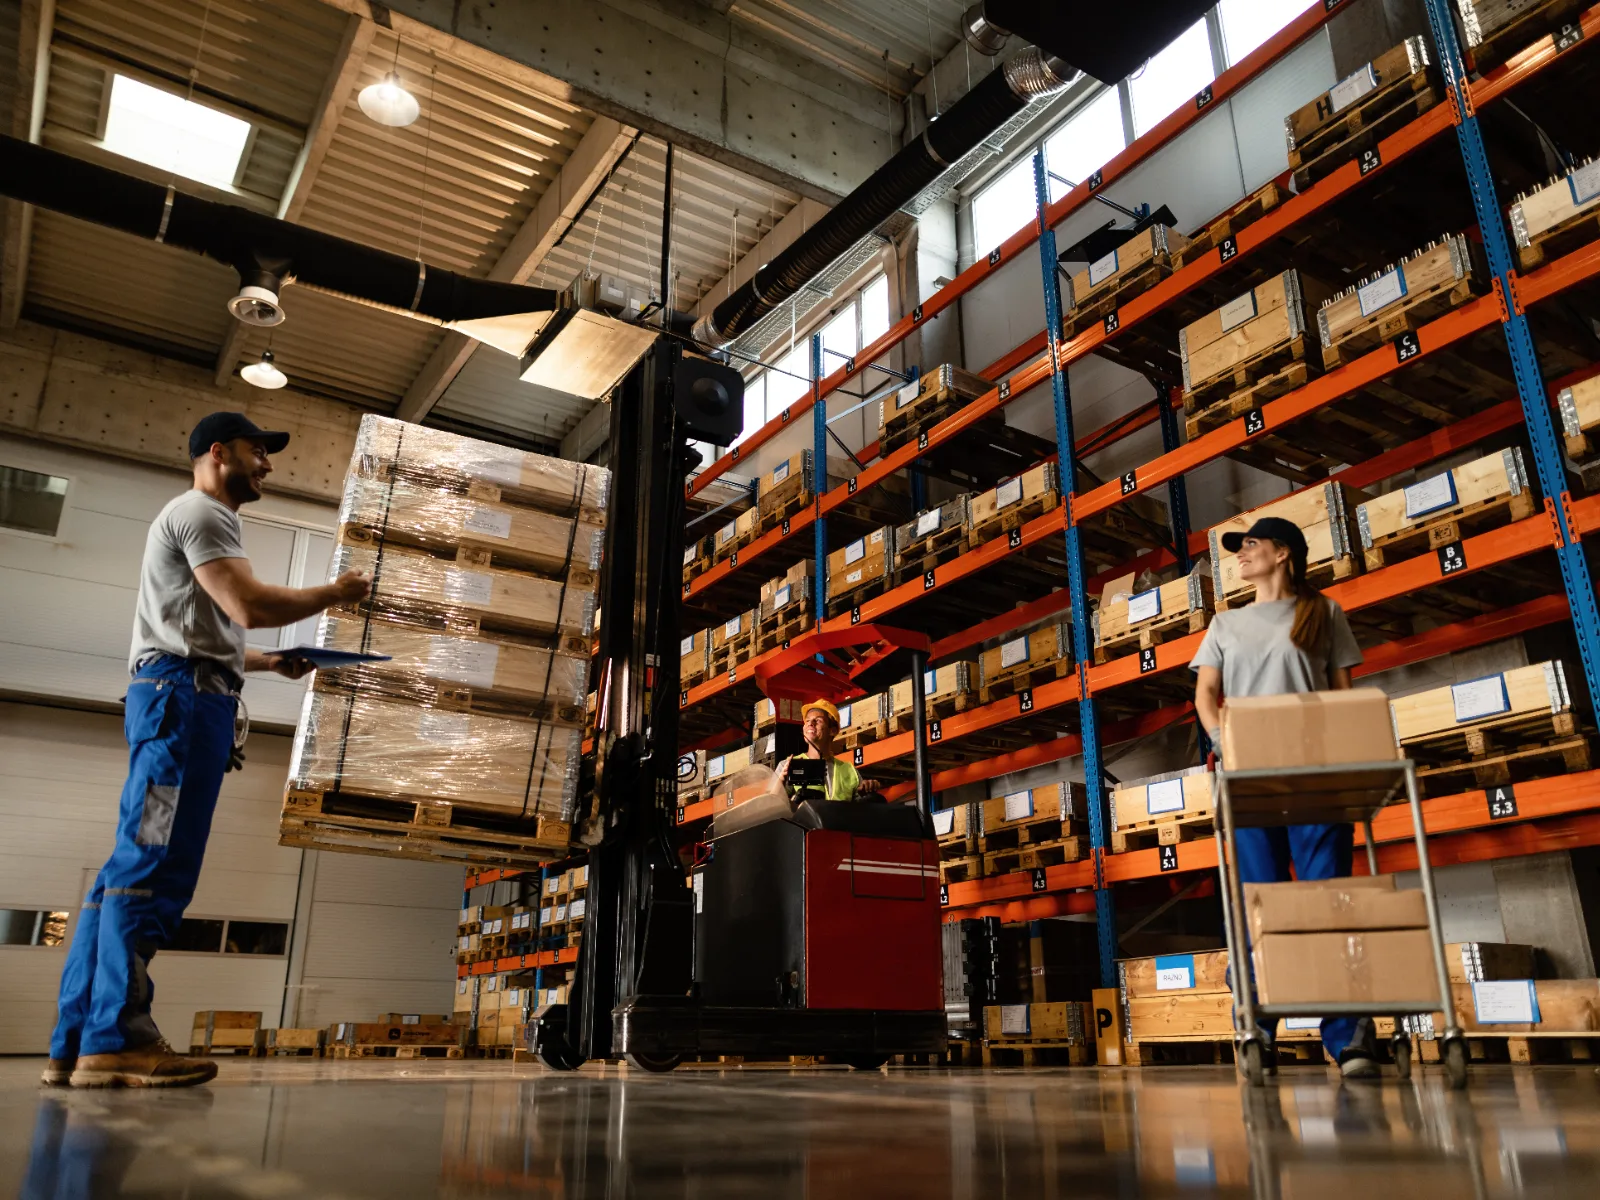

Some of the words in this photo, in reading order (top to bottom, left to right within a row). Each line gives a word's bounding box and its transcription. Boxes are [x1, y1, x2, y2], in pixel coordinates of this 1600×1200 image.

[1562, 24, 1572, 35] D
[1560, 31, 1579, 48] 6.1
[1198, 95, 1211, 107] 5.2
[1364, 151, 1372, 161] D
[1362, 157, 1378, 172] 5.3
[1091, 177, 1102, 188] 5.1
[1224, 241, 1231, 249] D
[1223, 247, 1235, 260] 5.2
[1107, 321, 1117, 332] 5.1
[1402, 335, 1410, 346] C
[1400, 344, 1417, 359] 5.3
[1000, 389, 1010, 399] 4.3
[1250, 411, 1257, 420] C
[1248, 420, 1262, 433] 5.2
[1125, 473, 1131, 482] C
[1124, 481, 1135, 493] 5.1
[1010, 537, 1020, 547] 4.3
[1446, 547, 1455, 558] B
[1444, 557, 1463, 572] 5.3
[927, 571, 932, 579] C
[1144, 650, 1151, 659] B
[1142, 660, 1154, 671] 5.1
[1023, 692, 1029, 700] B
[1021, 700, 1031, 710] 4.3
[931, 731, 940, 740] 4.2
[856, 748, 861, 756] B
[1496, 789, 1506, 801] A
[1492, 801, 1513, 816] 5.3
[1165, 847, 1172, 857] A
[1163, 858, 1175, 868] 5.1
[1036, 870, 1042, 879] A
[1034, 880, 1045, 889] 4.3
[940, 886, 945, 895] A
[1096, 1008, 1113, 1038] P
